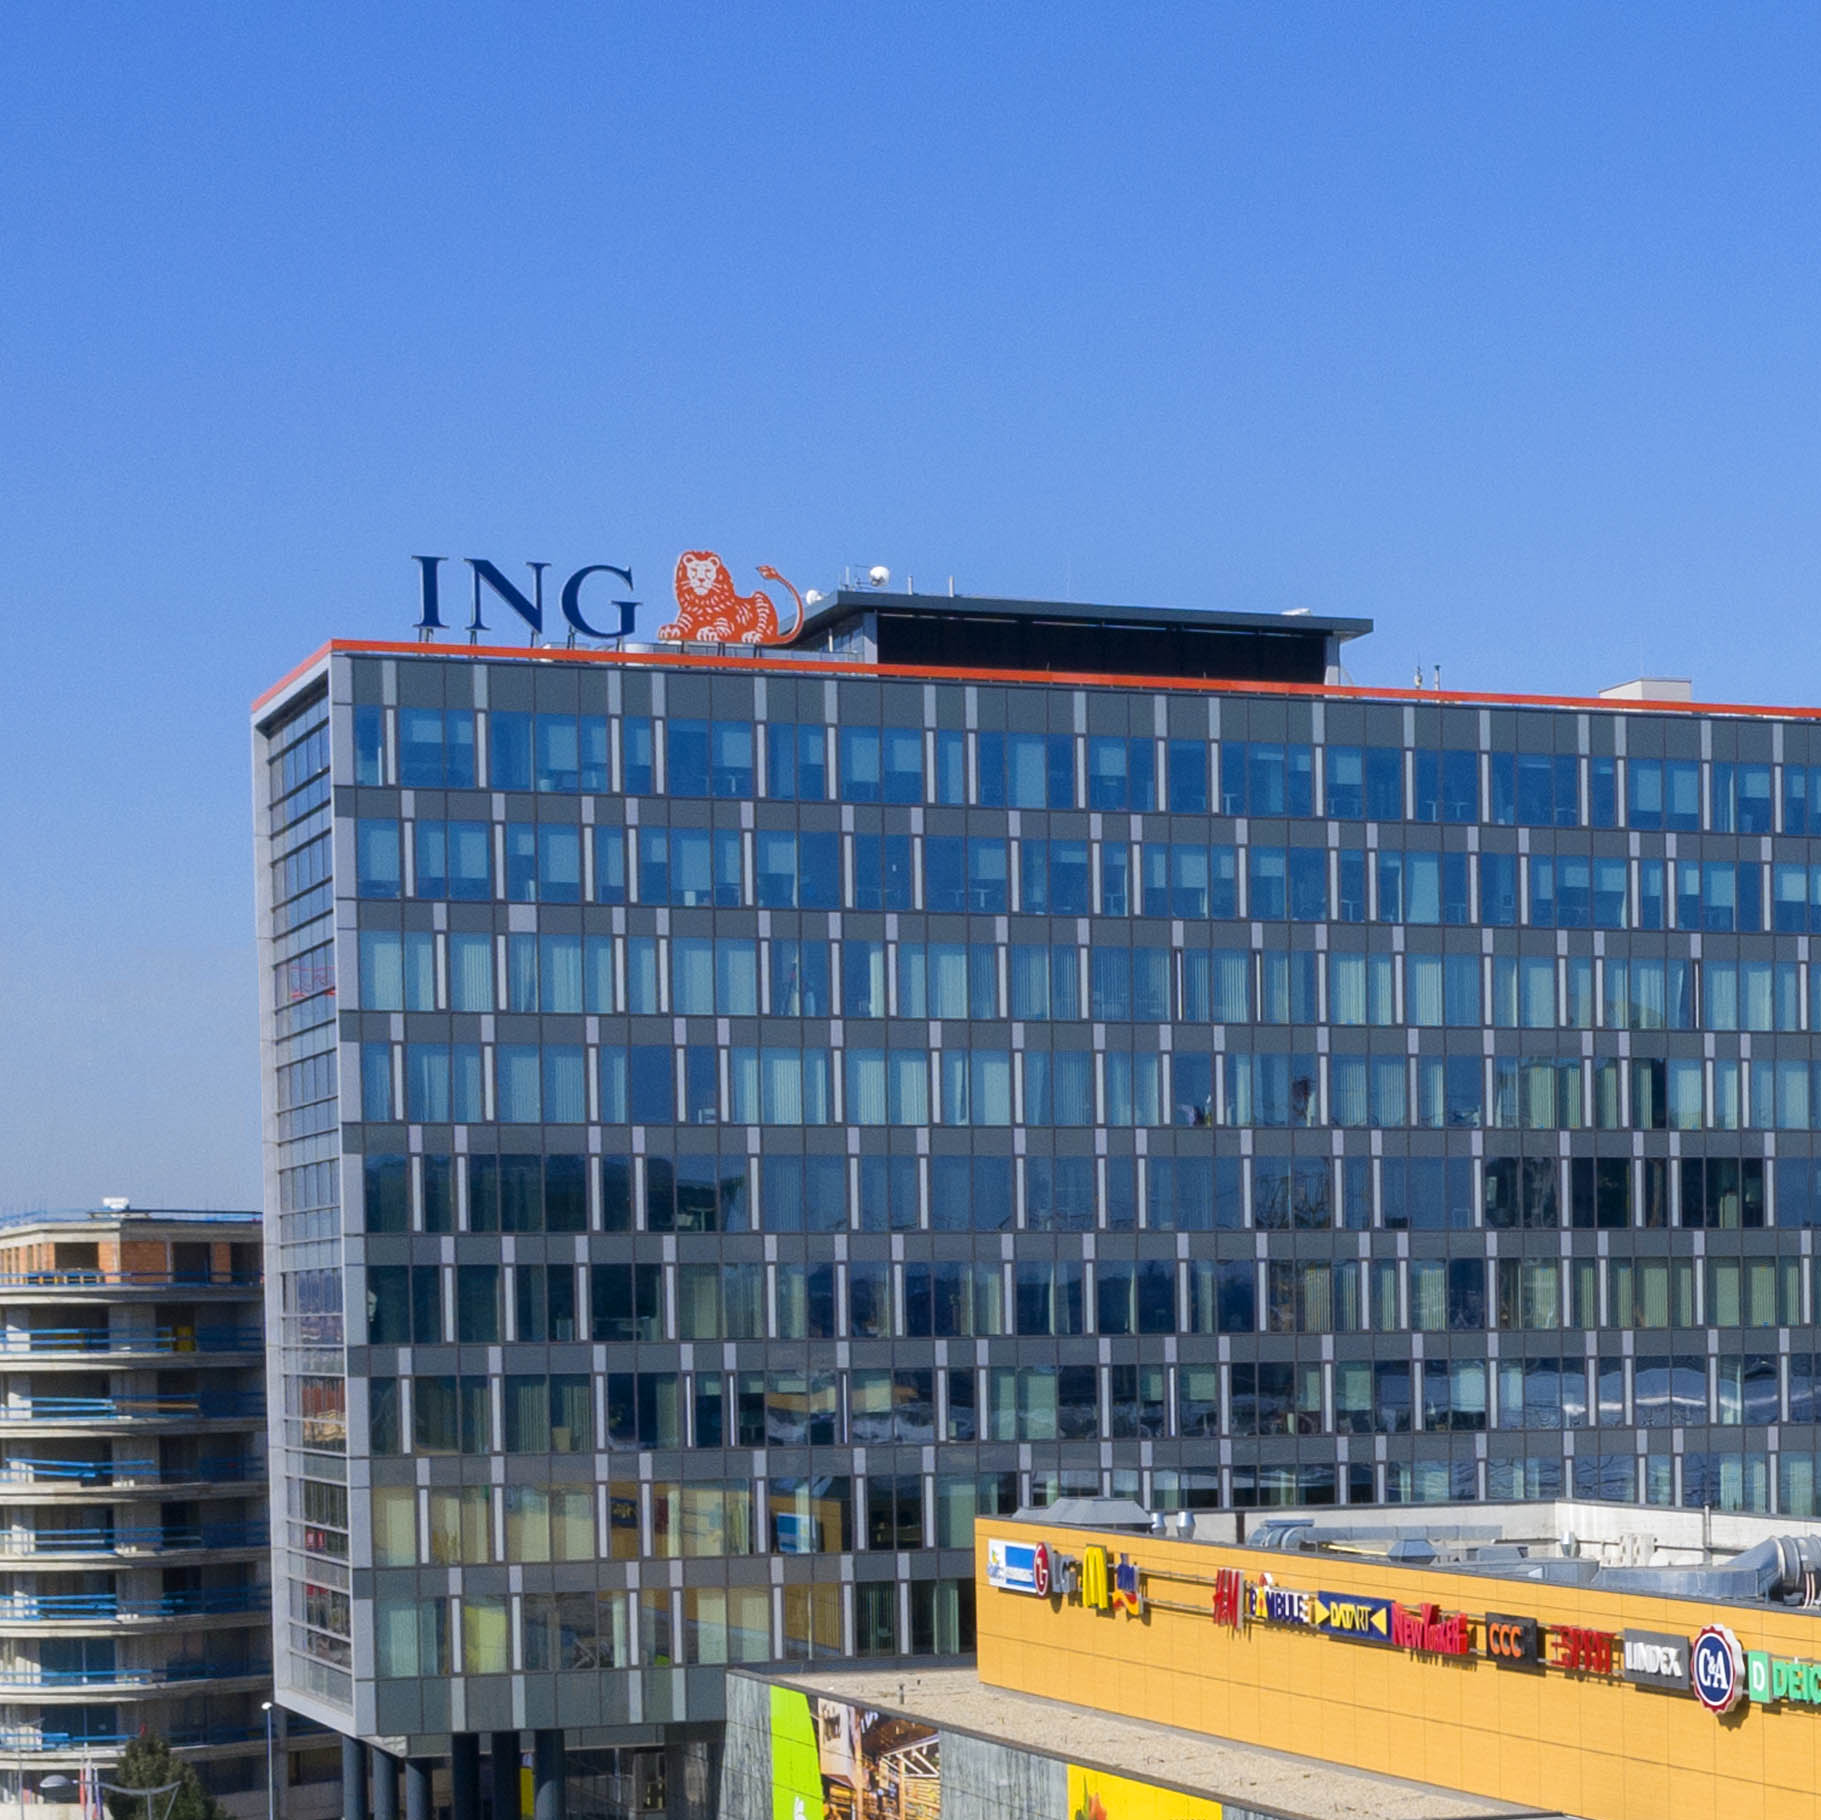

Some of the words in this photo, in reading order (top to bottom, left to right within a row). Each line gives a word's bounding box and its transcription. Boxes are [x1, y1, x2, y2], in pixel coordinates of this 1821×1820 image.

[411, 555, 643, 639] ING
[1329, 1601, 1372, 1631] DATART
[1489, 1622, 1521, 1658] CCC
[1698, 1648, 1729, 1690] C&A
